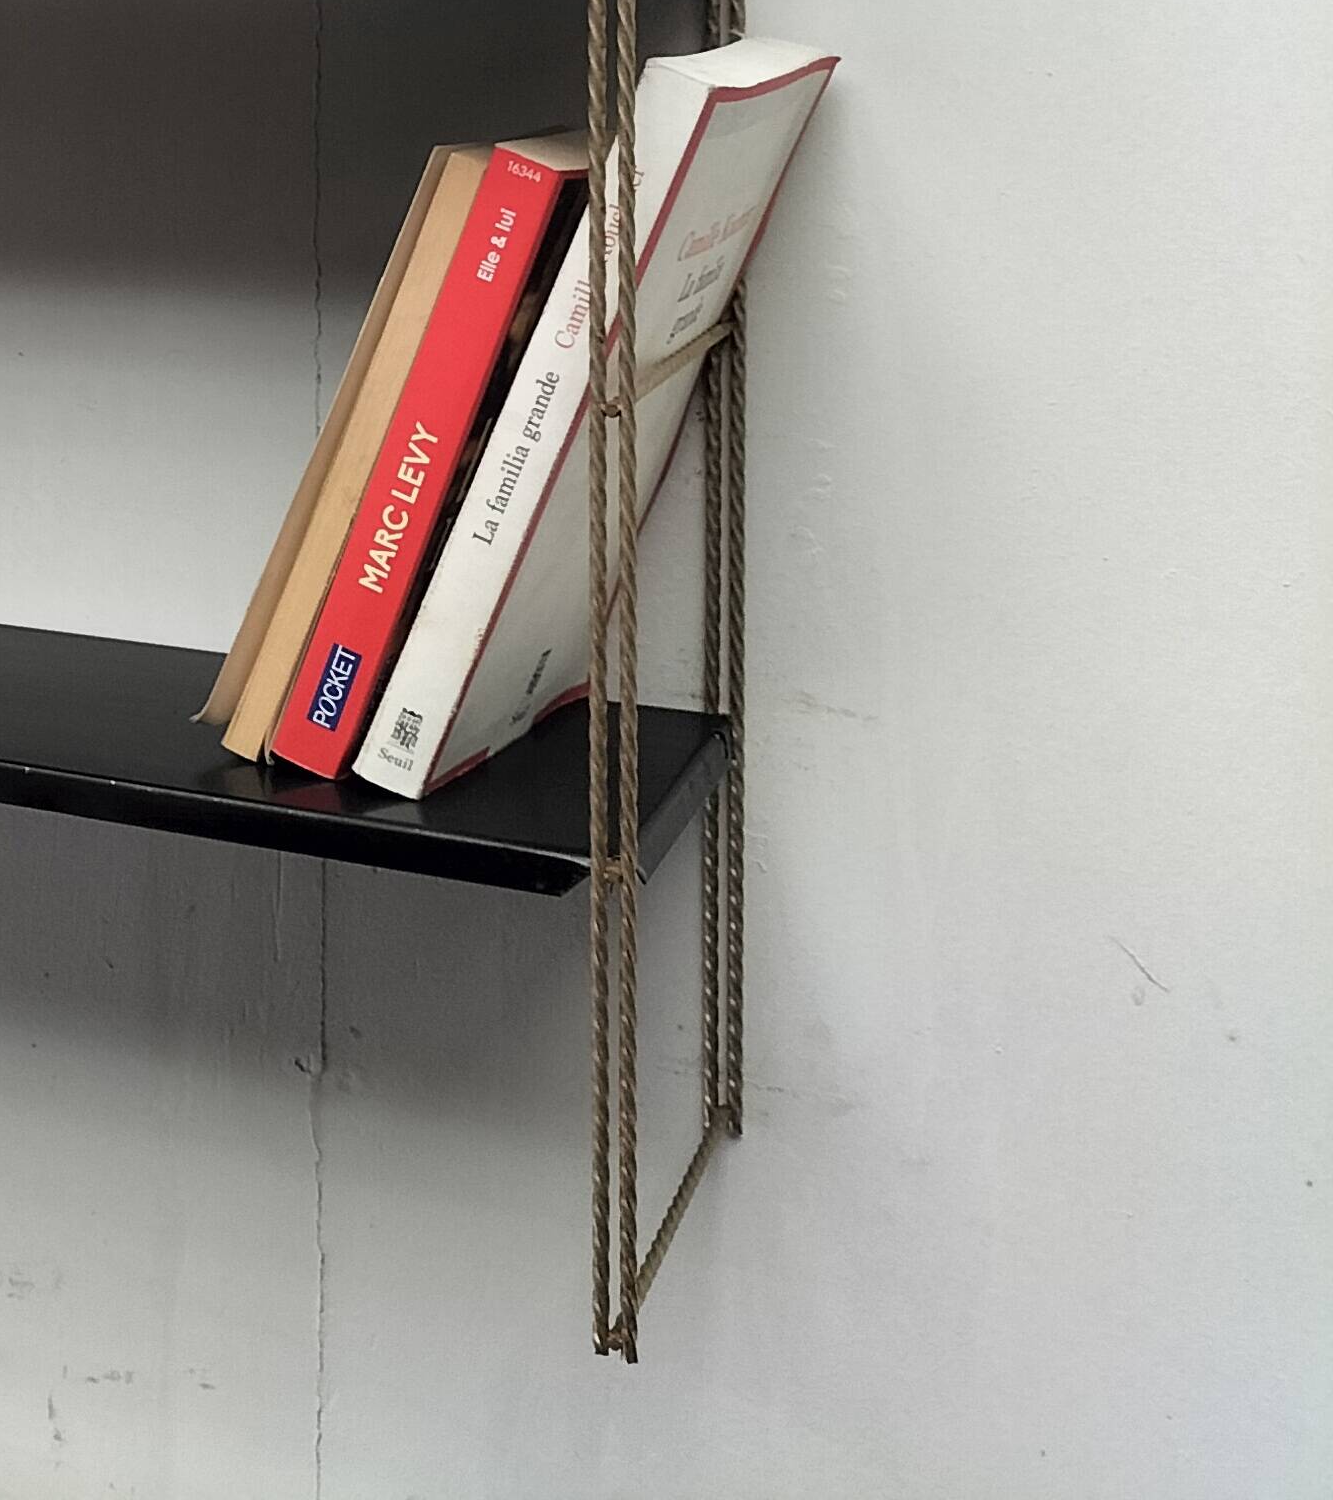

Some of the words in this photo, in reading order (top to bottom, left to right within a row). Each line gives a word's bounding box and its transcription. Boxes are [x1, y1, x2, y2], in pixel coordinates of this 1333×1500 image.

[507, 160, 542, 183] 16344
[476, 252, 501, 283] Elle
[491, 236, 508, 250] &
[554, 279, 591, 350] Camill
[522, 371, 561, 443] grande
[358, 504, 409, 594] MARC
[391, 421, 439, 505] LEVY
[485, 445, 531, 516] familia
[472, 520, 500, 546] La
[312, 644, 357, 729] POCKET
[377, 747, 414, 772] Seuil
